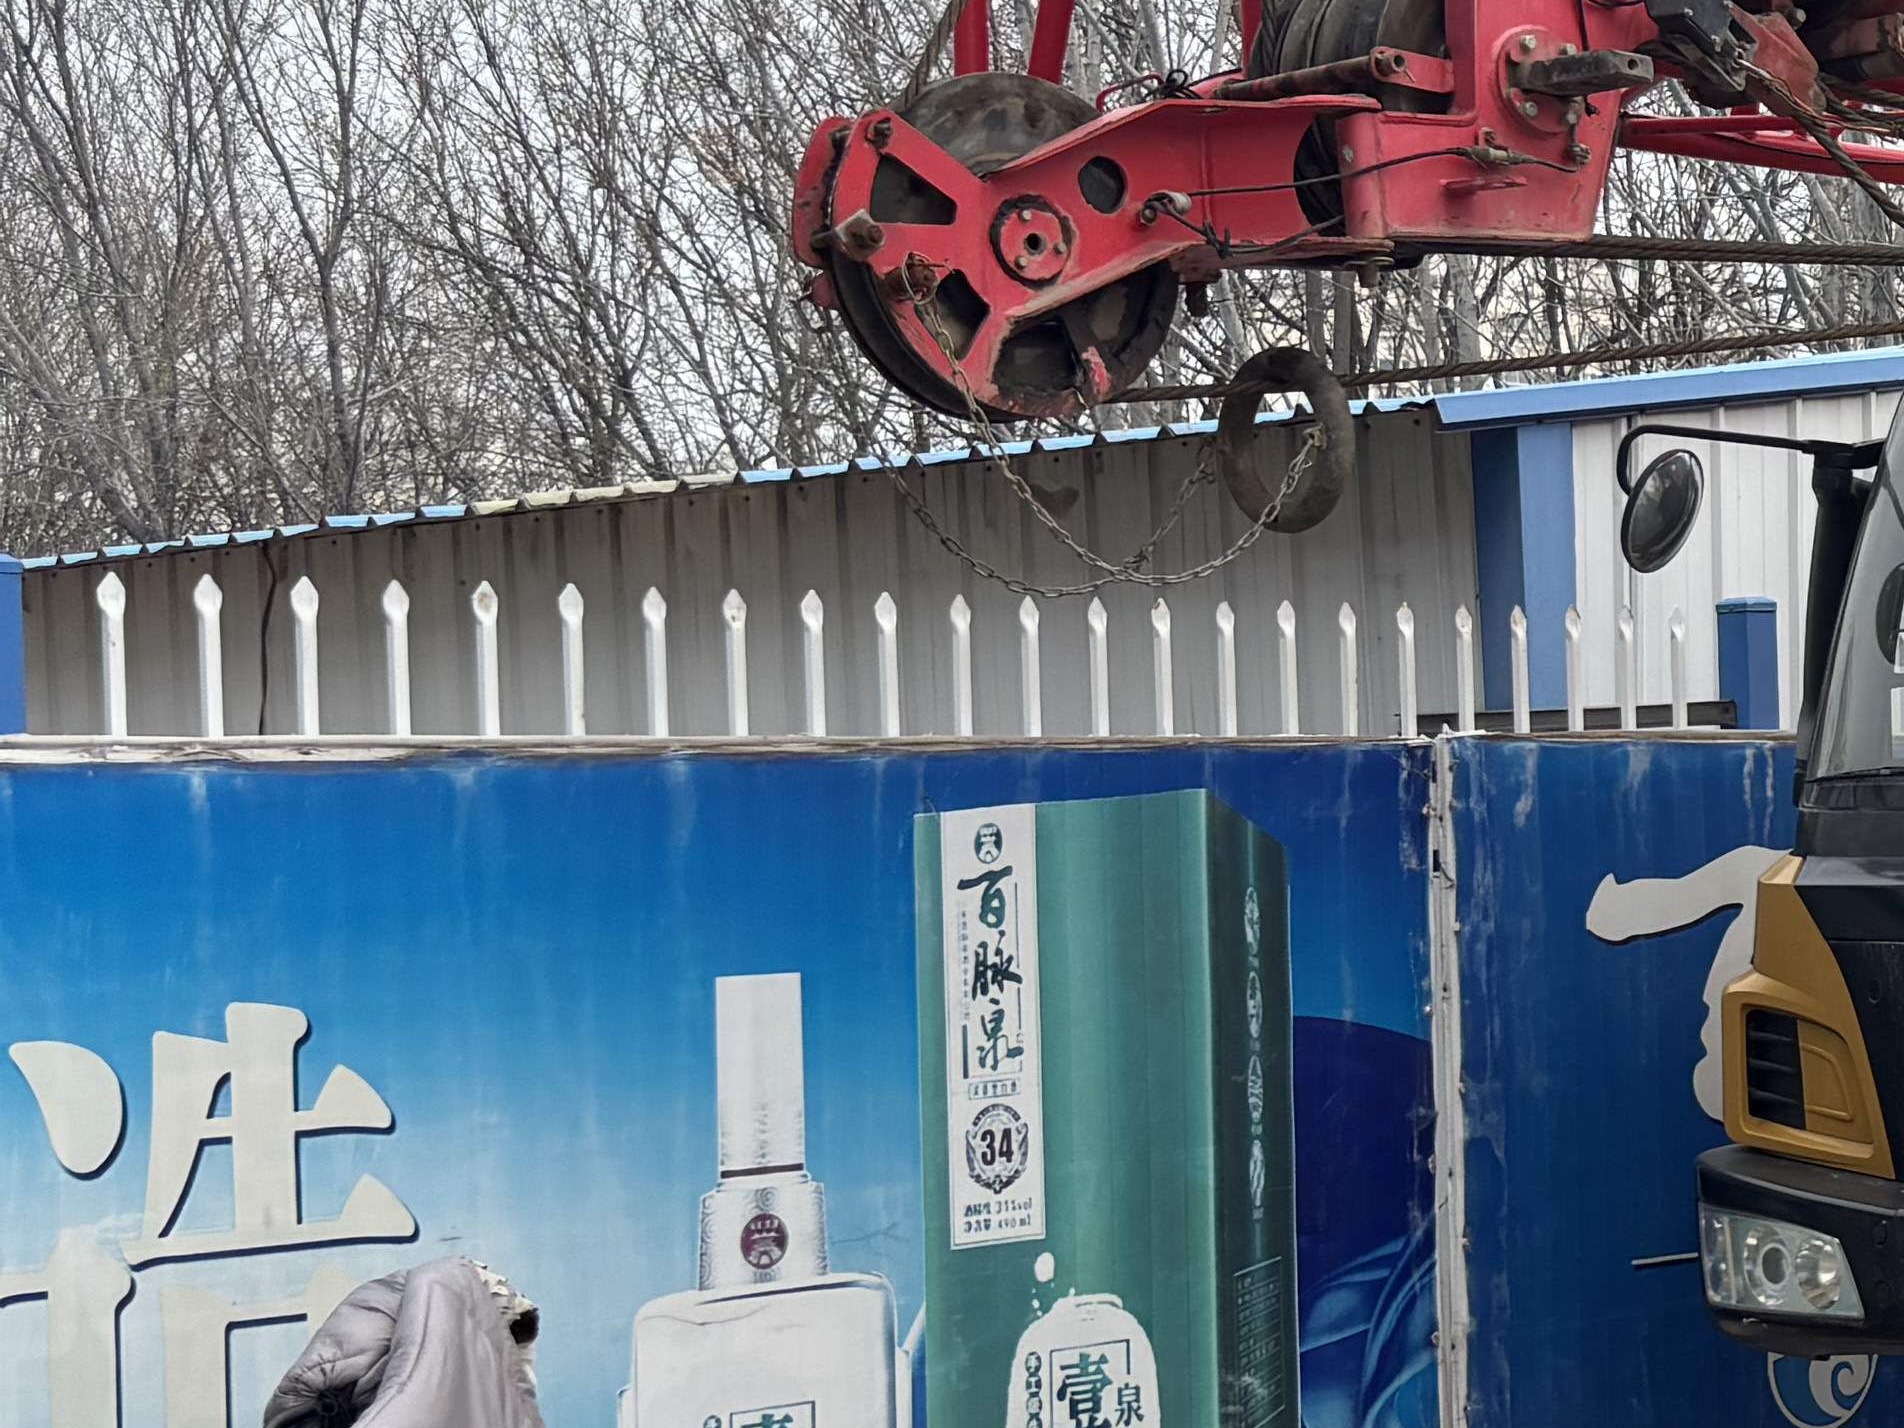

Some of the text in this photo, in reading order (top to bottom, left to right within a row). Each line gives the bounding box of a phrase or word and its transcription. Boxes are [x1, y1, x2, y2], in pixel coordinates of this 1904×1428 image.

[957, 865, 1024, 1071] 百脉泉
[981, 1128, 1014, 1167] 34
